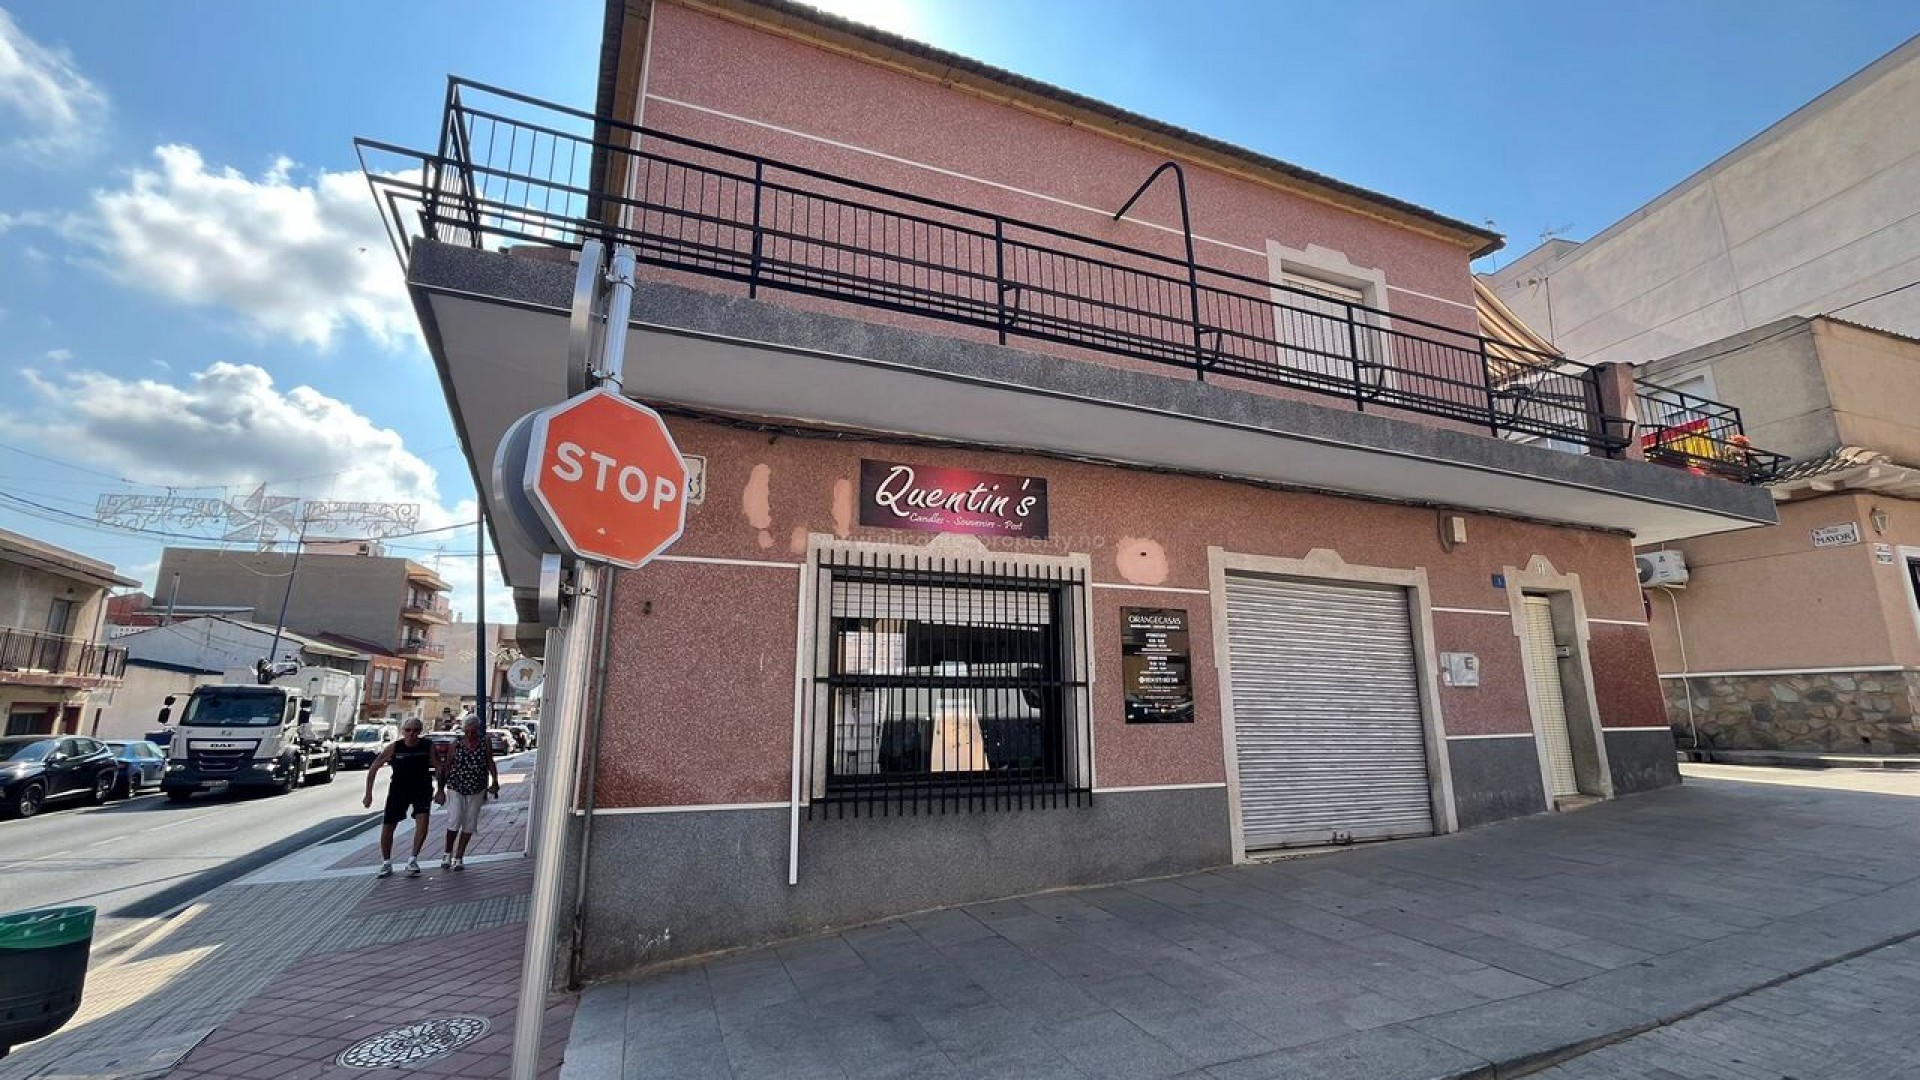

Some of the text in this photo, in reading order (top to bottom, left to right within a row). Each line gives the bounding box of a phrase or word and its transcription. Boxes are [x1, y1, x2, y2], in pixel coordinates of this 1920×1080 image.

[552, 442, 677, 511] STOP
[875, 465, 1037, 517] Quentin's
[909, 512, 944, 524] Candles
[1816, 533, 1852, 544] MAYOR
[1128, 615, 1182, 625] ORANGECASAS
